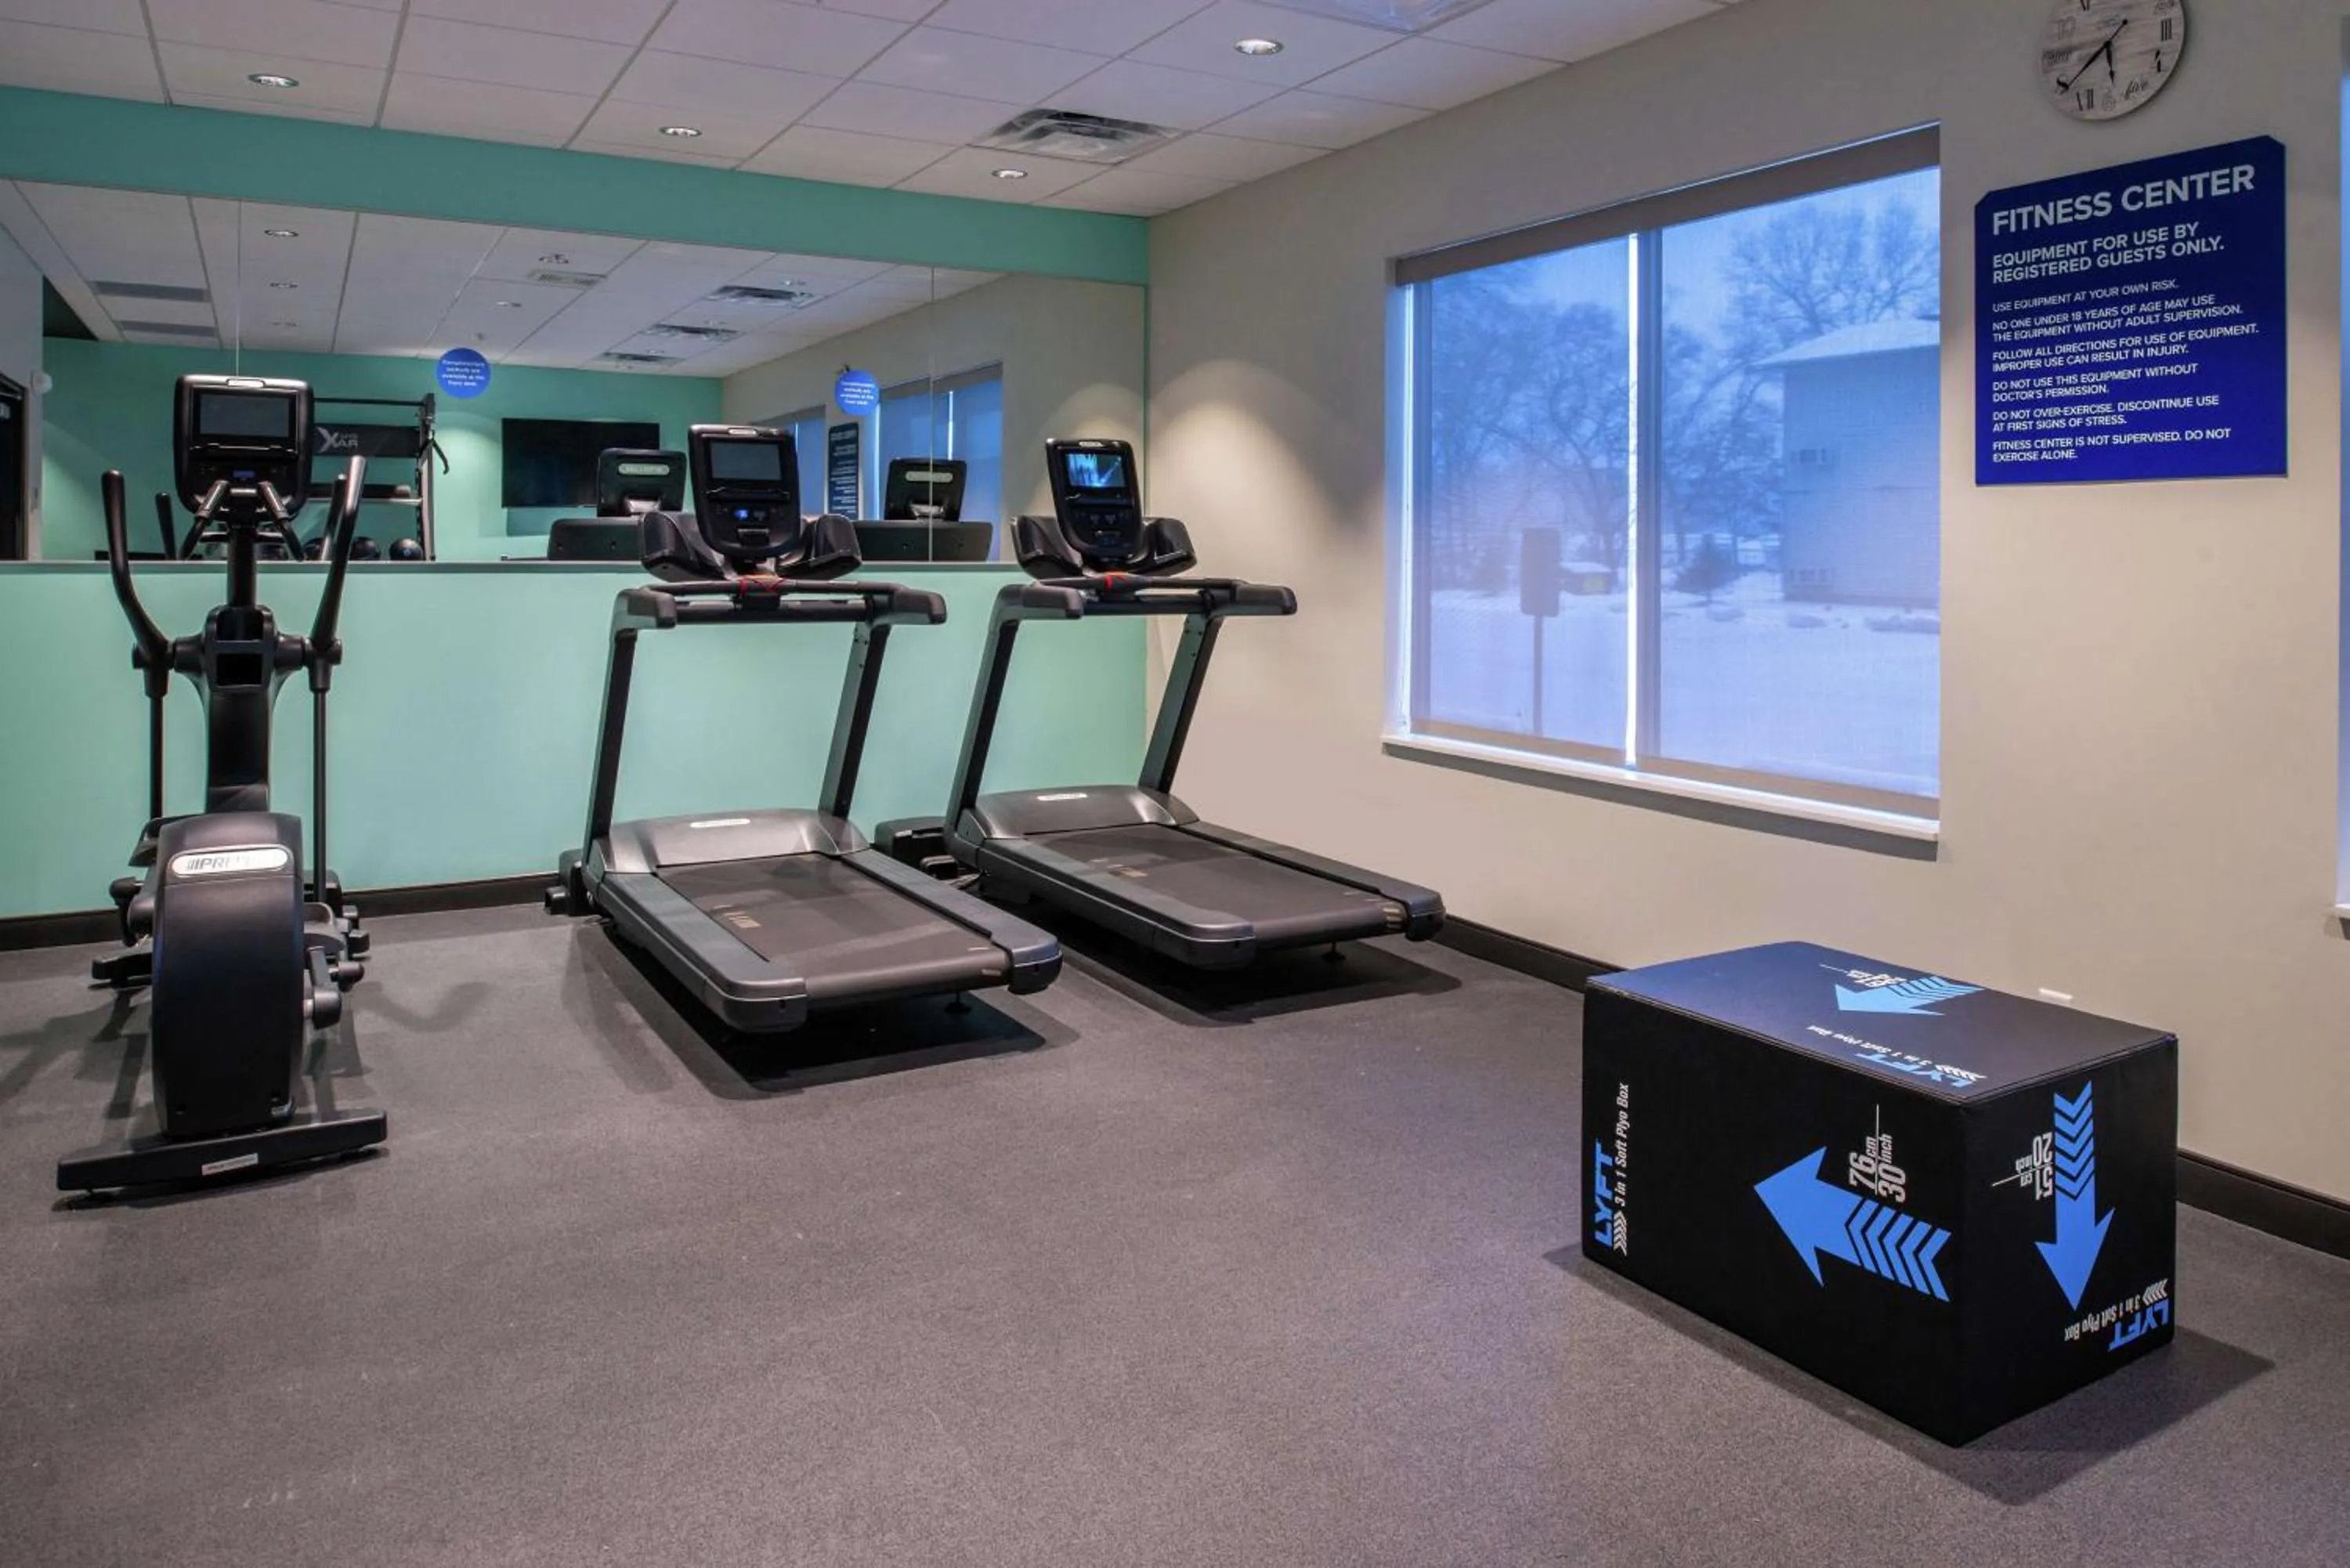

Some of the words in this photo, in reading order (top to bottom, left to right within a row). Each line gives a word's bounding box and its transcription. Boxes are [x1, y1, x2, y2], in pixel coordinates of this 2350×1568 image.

[1994, 192, 2112, 235] FITNESS
[2121, 164, 2254, 211] CENTER
[1994, 240, 2088, 268] EQUIPMENT
[2093, 234, 2128, 251] FOR
[2134, 227, 2168, 245] USE
[2175, 222, 2198, 239] BY
[1993, 257, 2092, 284] REGISTERED
[2097, 244, 2166, 267] GUESTS
[2171, 236, 2224, 256] ONLY.
[1993, 302, 2012, 312] USE
[2014, 294, 2071, 309] EQUIPMENT
[2074, 291, 2087, 301] AT
[2089, 287, 2118, 298] YOUR
[2121, 283, 2148, 294] OWN
[2152, 279, 2178, 291] RISK.
[1993, 321, 2008, 331] NO
[2010, 318, 2031, 328] ONE
[2034, 313, 2069, 326] UNDER
[2072, 312, 2082, 320] 18
[2084, 307, 2118, 319] YEARS
[2120, 304, 2135, 315] OF
[2139, 301, 2161, 313] AGE
[2164, 298, 2189, 309] MAY
[2192, 294, 2214, 306] USE
[1993, 332, 2012, 341] THE
[2015, 324, 2071, 340] EQUIPMENT
[2074, 318, 2123, 332] WITHOUT
[2125, 313, 2160, 327] ADULT
[2164, 305, 2242, 322] SUPERVISION.
[1993, 349, 2033, 360] FOLLOW
[2035, 346, 2052, 356] ALL
[2055, 339, 2117, 355] DIRECTIONS
[2120, 336, 2142, 347] FOR
[2145, 334, 2166, 345] USE
[2169, 331, 2186, 341] OF
[2189, 323, 2258, 340] EQUIPMENT.
[1993, 359, 2041, 371] IMPROPER
[2044, 356, 2064, 367] USE
[2066, 354, 2088, 365] CAN
[2092, 349, 2130, 362] RESULT
[2133, 349, 2144, 358] IN
[2147, 344, 2189, 356] INJURY.
[1993, 381, 2008, 391] DO
[2010, 379, 2030, 388] NOT
[2034, 377, 2052, 387] USE
[2055, 374, 2077, 385] THIS
[2081, 368, 2142, 383] EQUIPMENT
[2145, 363, 2197, 377] WITHOUT
[1993, 389, 2043, 403] DOCTOR'S
[2045, 385, 2109, 398] PERMISSION.
[1993, 411, 2008, 421] DO
[2010, 410, 2030, 419] NOT
[2034, 404, 2114, 417] OVER-EXERCISE.
[2118, 397, 2193, 412] DISCONTINUE
[2196, 395, 2218, 406] USE
[1993, 423, 2005, 432] AT
[2008, 421, 2034, 431] FIRST
[2036, 419, 2066, 429] SIGNS
[2068, 417, 2083, 427] OF
[2085, 415, 2127, 426] STRESS.
[1993, 440, 2031, 450] FITNESS
[2034, 438, 2073, 448] CENTER
[2075, 437, 2084, 446] IS
[2088, 435, 2110, 445] NOT
[2112, 432, 2181, 444] SUPERVISED.
[2185, 430, 2203, 440] DO
[2206, 428, 2231, 439] NOT
[1993, 451, 2038, 462] EXERCISE
[2041, 450, 2077, 459] ALONE.
[1854, 1053, 1974, 1088] LYFT
[1617, 1082, 1629, 1108] Box
[1616, 1111, 1630, 1140] Plyo
[1614, 1139, 1627, 1168] Soft
[1615, 1169, 1627, 1178] 1
[1595, 1139, 1613, 1247] LYFT
[1614, 1181, 1627, 1196] in
[1614, 1196, 1626, 1207] 3
[2119, 1302, 2124, 1317] 1
[2125, 1297, 2135, 1313] in
[2135, 1294, 2141, 1310] 3
[2082, 1313, 2100, 1333] Plyo
[2101, 1305, 2117, 1328] Soft
[2108, 1299, 2169, 1351] LYFT
[2064, 1322, 2081, 1342] Box
